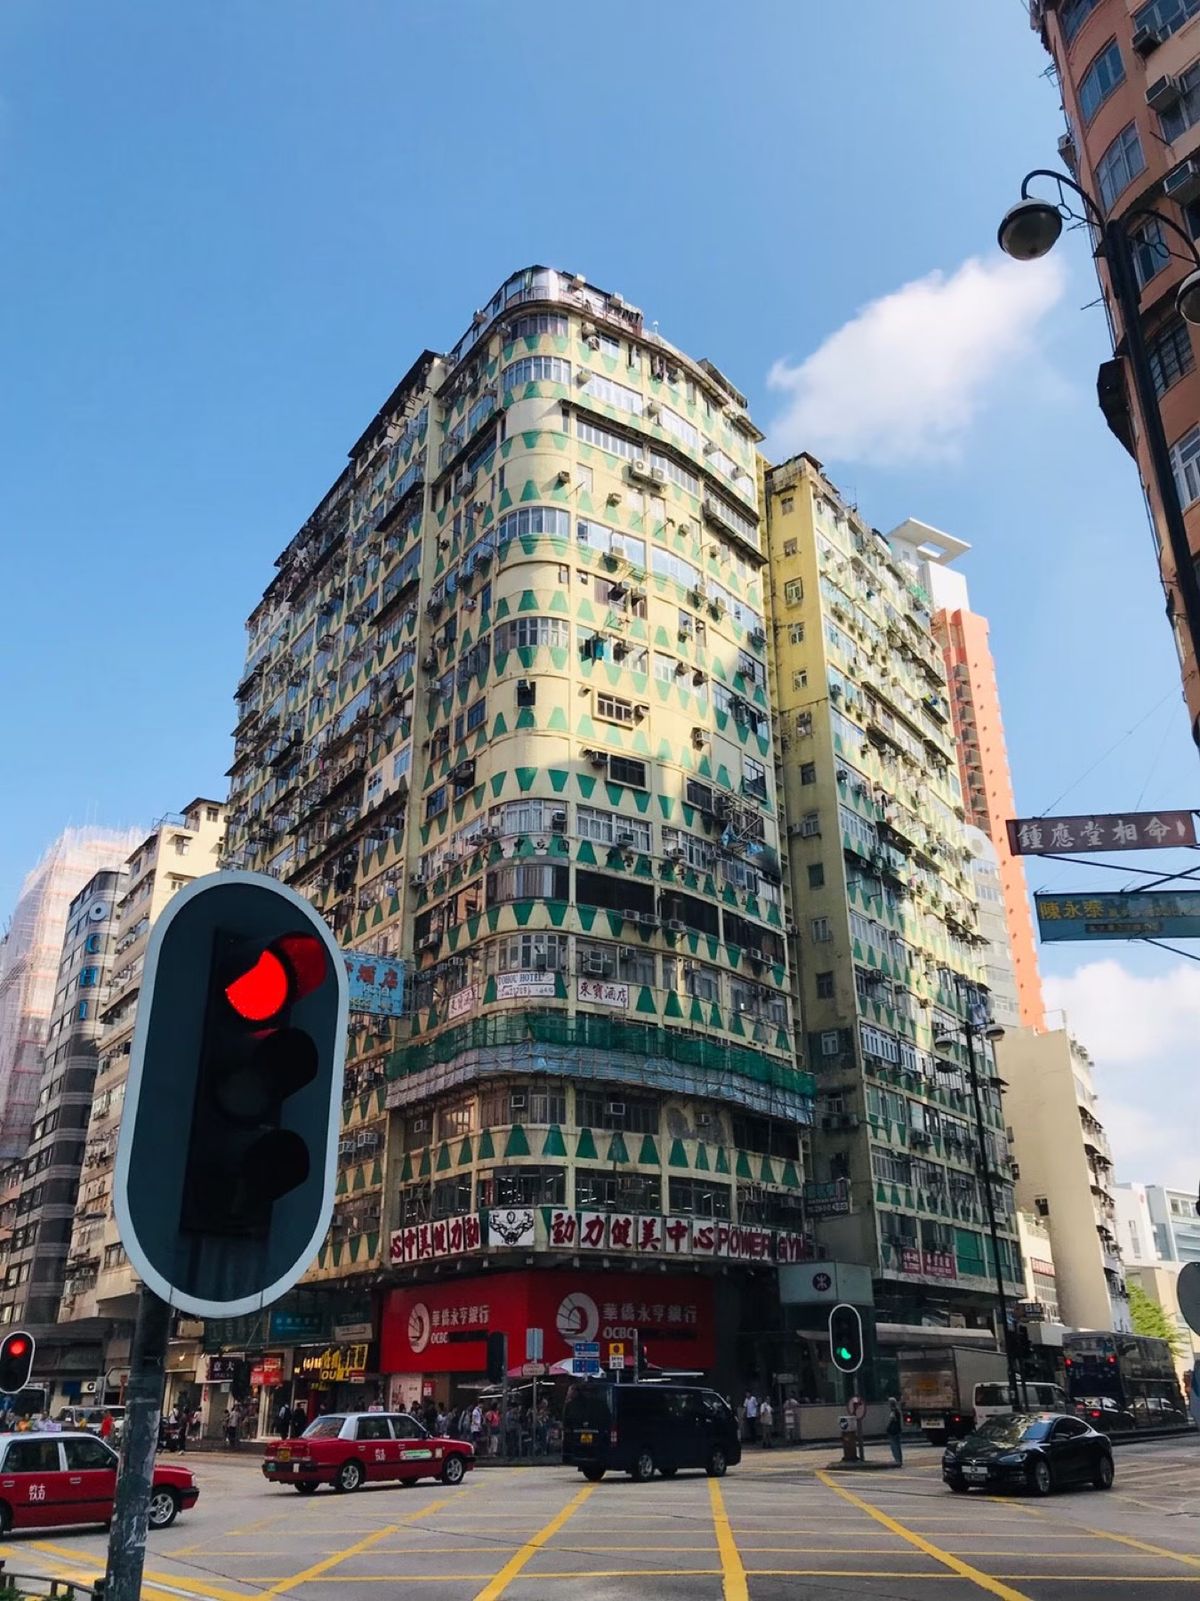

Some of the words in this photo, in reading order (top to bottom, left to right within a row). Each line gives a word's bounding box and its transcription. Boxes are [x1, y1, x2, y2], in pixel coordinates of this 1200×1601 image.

[1017, 816, 1171, 850] 鍾應堂相命
[551, 1211, 715, 1253] 動力健美中心
[716, 1226, 773, 1260] POWER
[431, 1304, 490, 1327] 華僑永亨銀行
[602, 1302, 697, 1323] 華僑永亨銀行
[430, 1331, 449, 1345] OCBC
[602, 1326, 636, 1340] OCBC
[28, 1483, 46, 1493] 的士
[28, 1492, 46, 1501] TAXI
